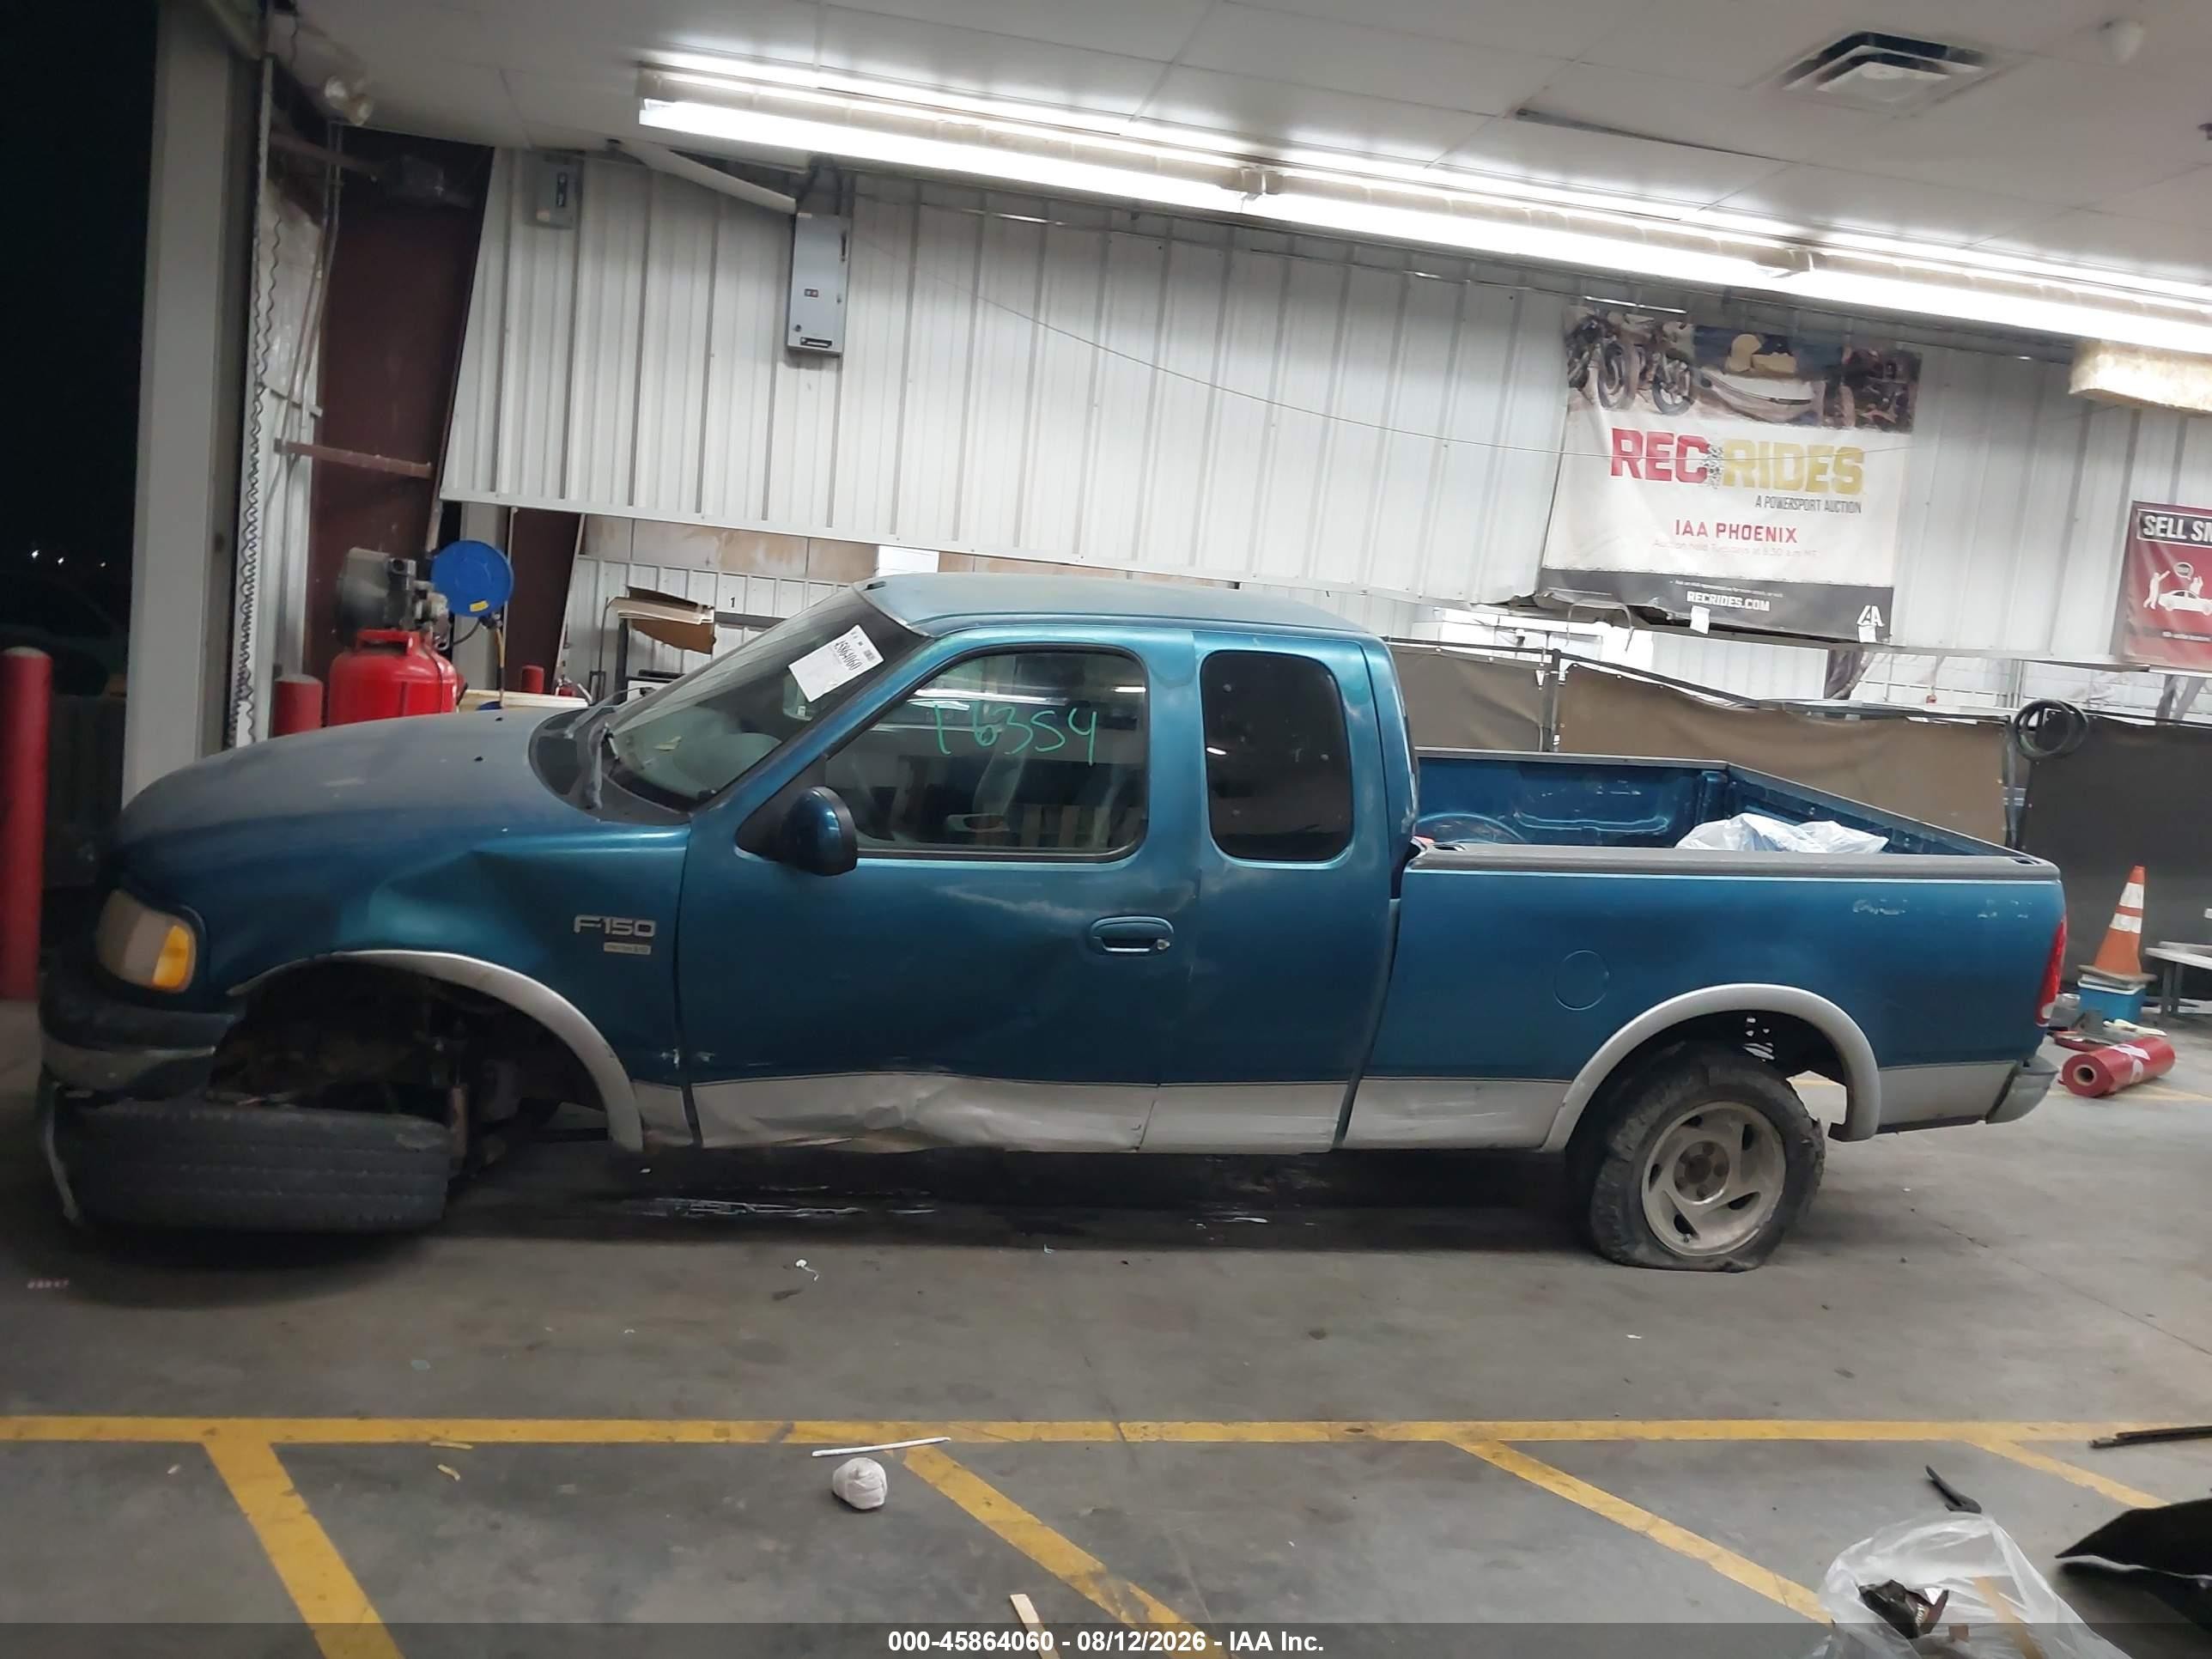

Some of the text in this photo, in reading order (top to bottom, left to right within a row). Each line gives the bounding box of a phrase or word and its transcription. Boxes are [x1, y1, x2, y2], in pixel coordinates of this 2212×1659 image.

[1611, 428, 1865, 495] REC RIDES
[1755, 495, 1862, 514] A POWERSPORT AUCTION
[1675, 519, 1797, 544] IAA PHOENIX
[2142, 514, 2187, 539] SELL
[1686, 590, 1770, 611] RECRIDES.COM
[573, 914, 657, 938] F150
